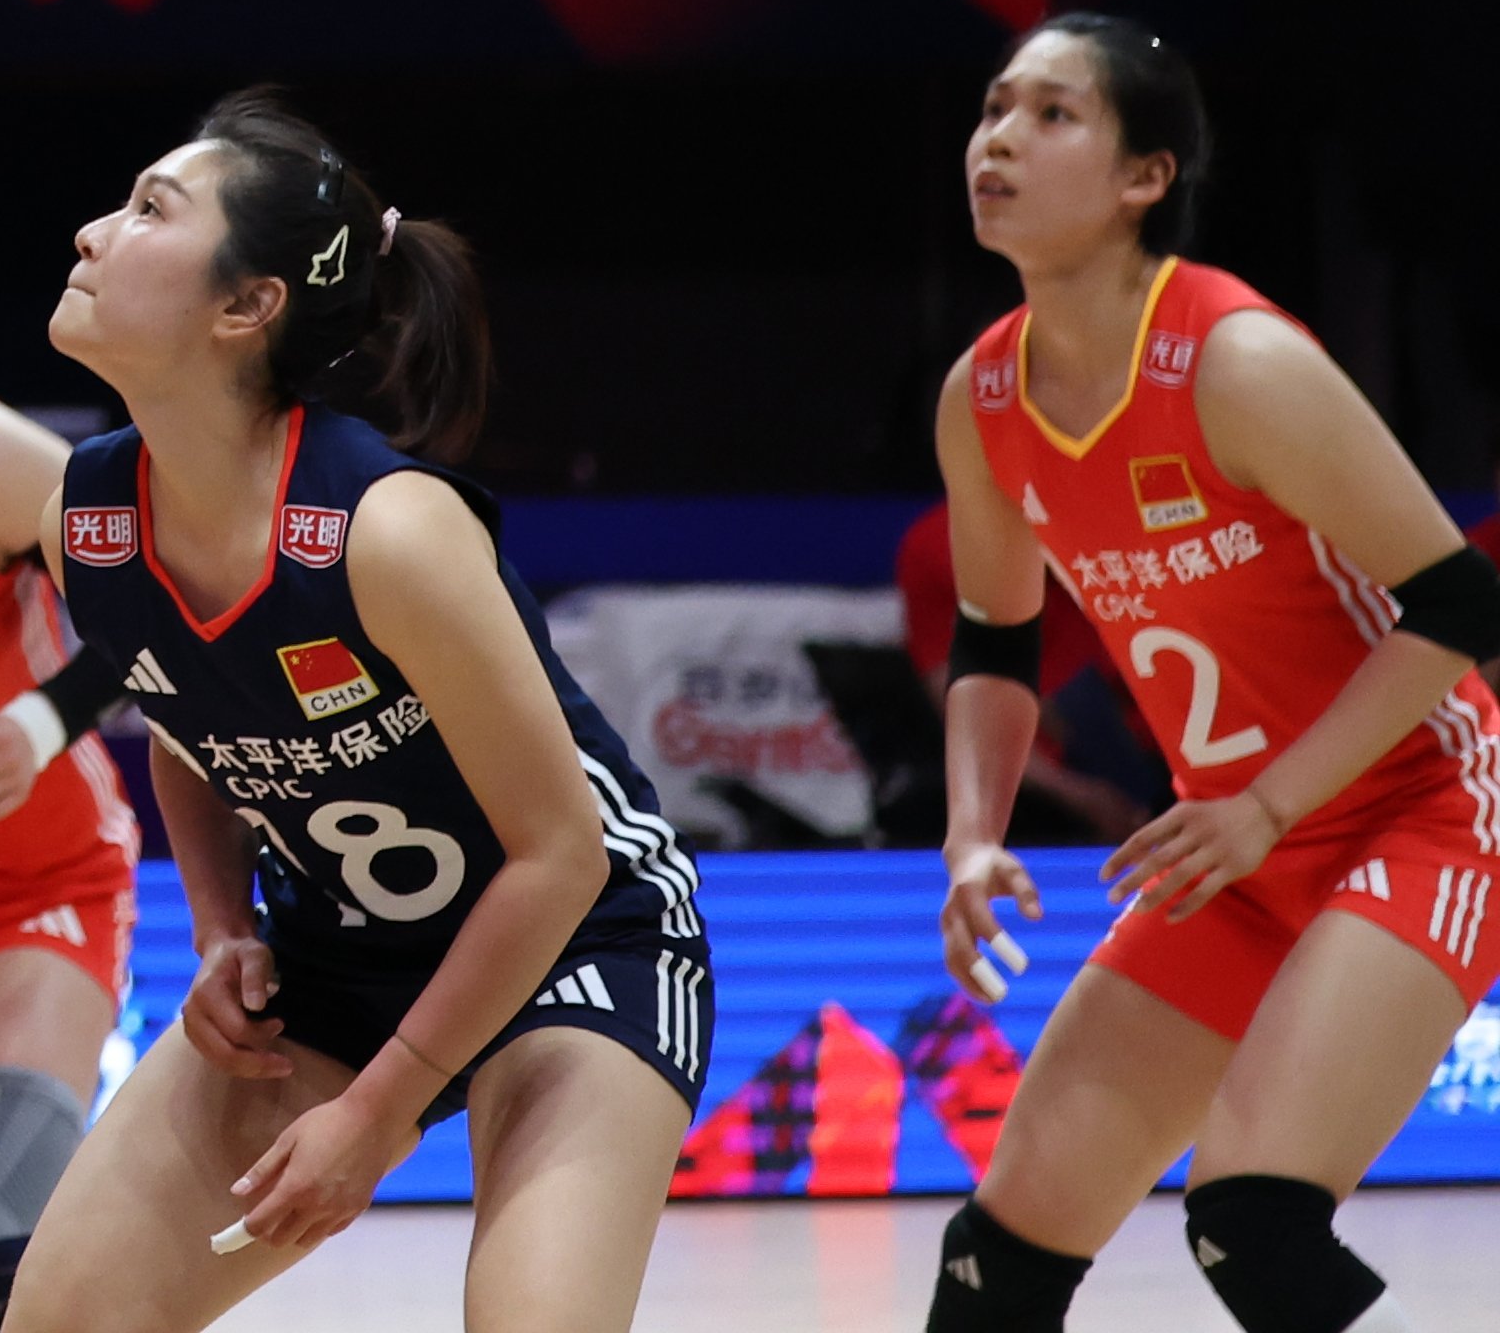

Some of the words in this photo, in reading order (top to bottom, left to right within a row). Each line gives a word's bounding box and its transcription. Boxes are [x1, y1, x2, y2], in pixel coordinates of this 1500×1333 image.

[70, 511, 133, 547] 光明
[285, 512, 343, 548] 光明
[1071, 520, 1266, 591] 太平洋保险
[310, 683, 368, 713] CHN
[1126, 626, 1269, 770] 2
[197, 693, 432, 775] 太平洋保险
[225, 774, 313, 801] CPIC
